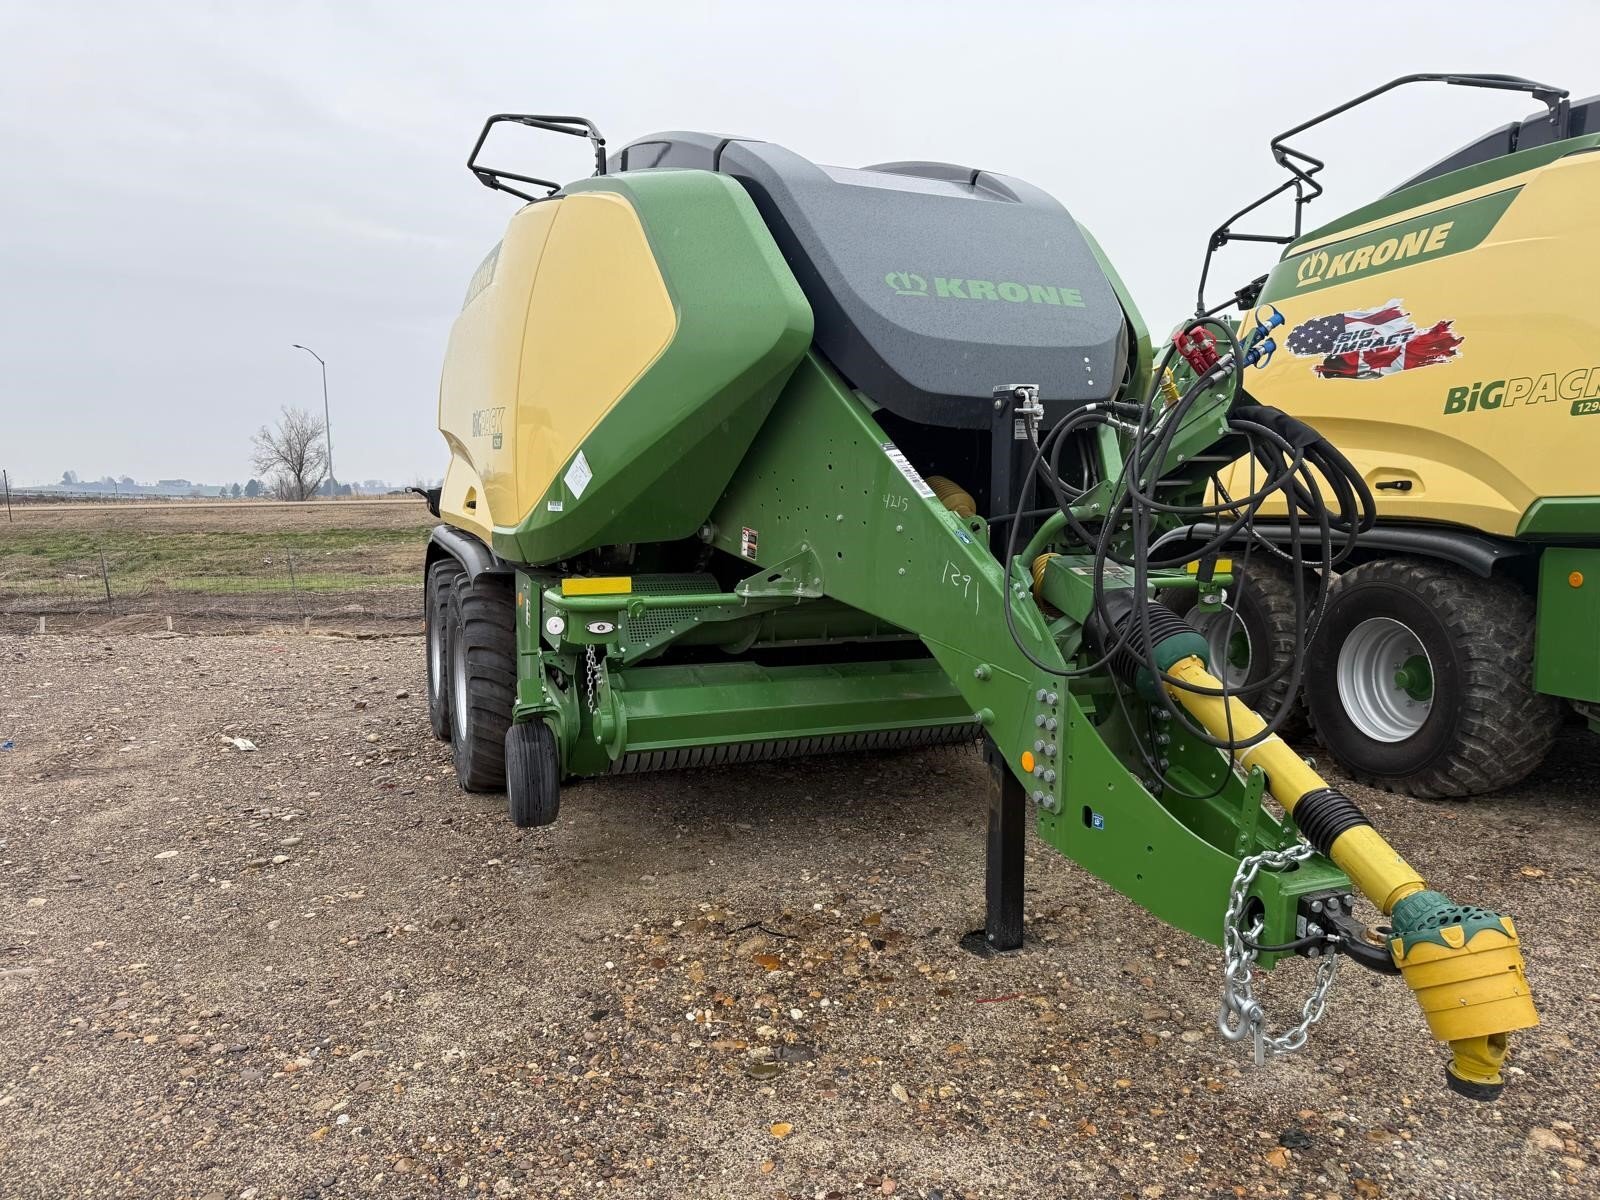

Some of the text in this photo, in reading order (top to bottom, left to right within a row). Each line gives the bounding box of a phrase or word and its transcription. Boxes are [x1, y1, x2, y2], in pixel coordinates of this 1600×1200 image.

[1324, 221, 1455, 280] KRONE
[934, 277, 1087, 308] KRONE
[1332, 331, 1416, 355] IMPACT
[1337, 327, 1375, 344] BIG
[1577, 401, 1600, 413] 129
[882, 492, 909, 512] 4215
